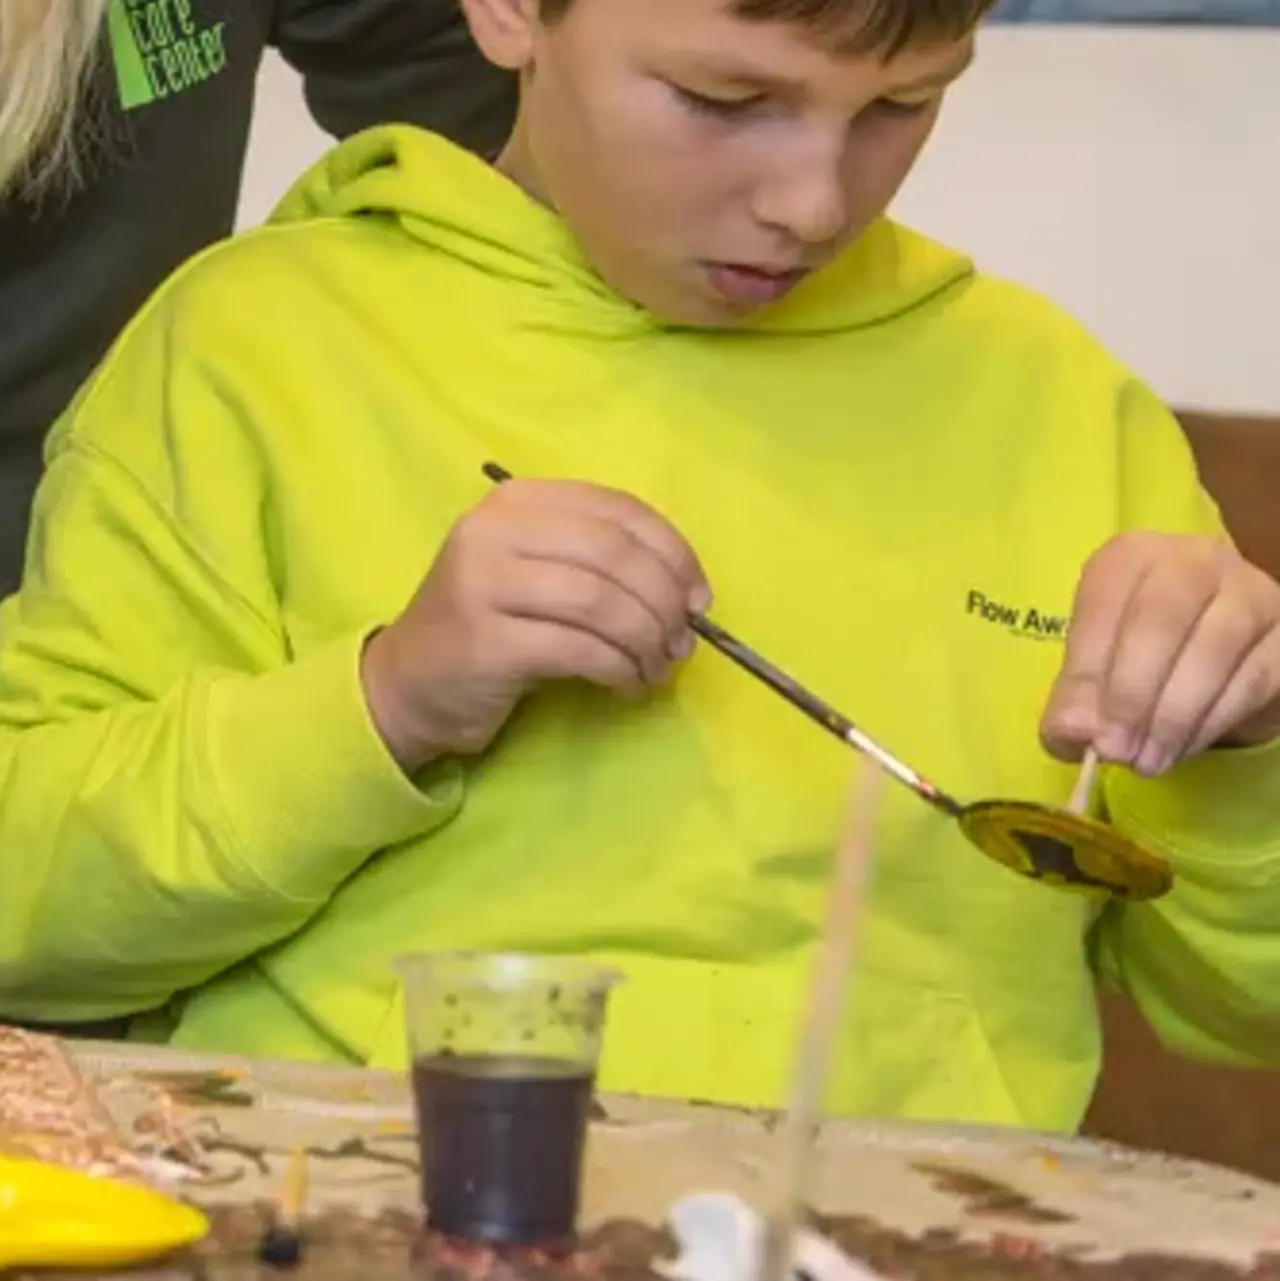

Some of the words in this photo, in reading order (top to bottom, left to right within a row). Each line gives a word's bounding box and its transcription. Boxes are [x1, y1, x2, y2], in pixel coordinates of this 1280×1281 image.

[146, 21, 227, 98] center
[965, 588, 1020, 628] Flow
[1022, 607, 1068, 635] Aw
